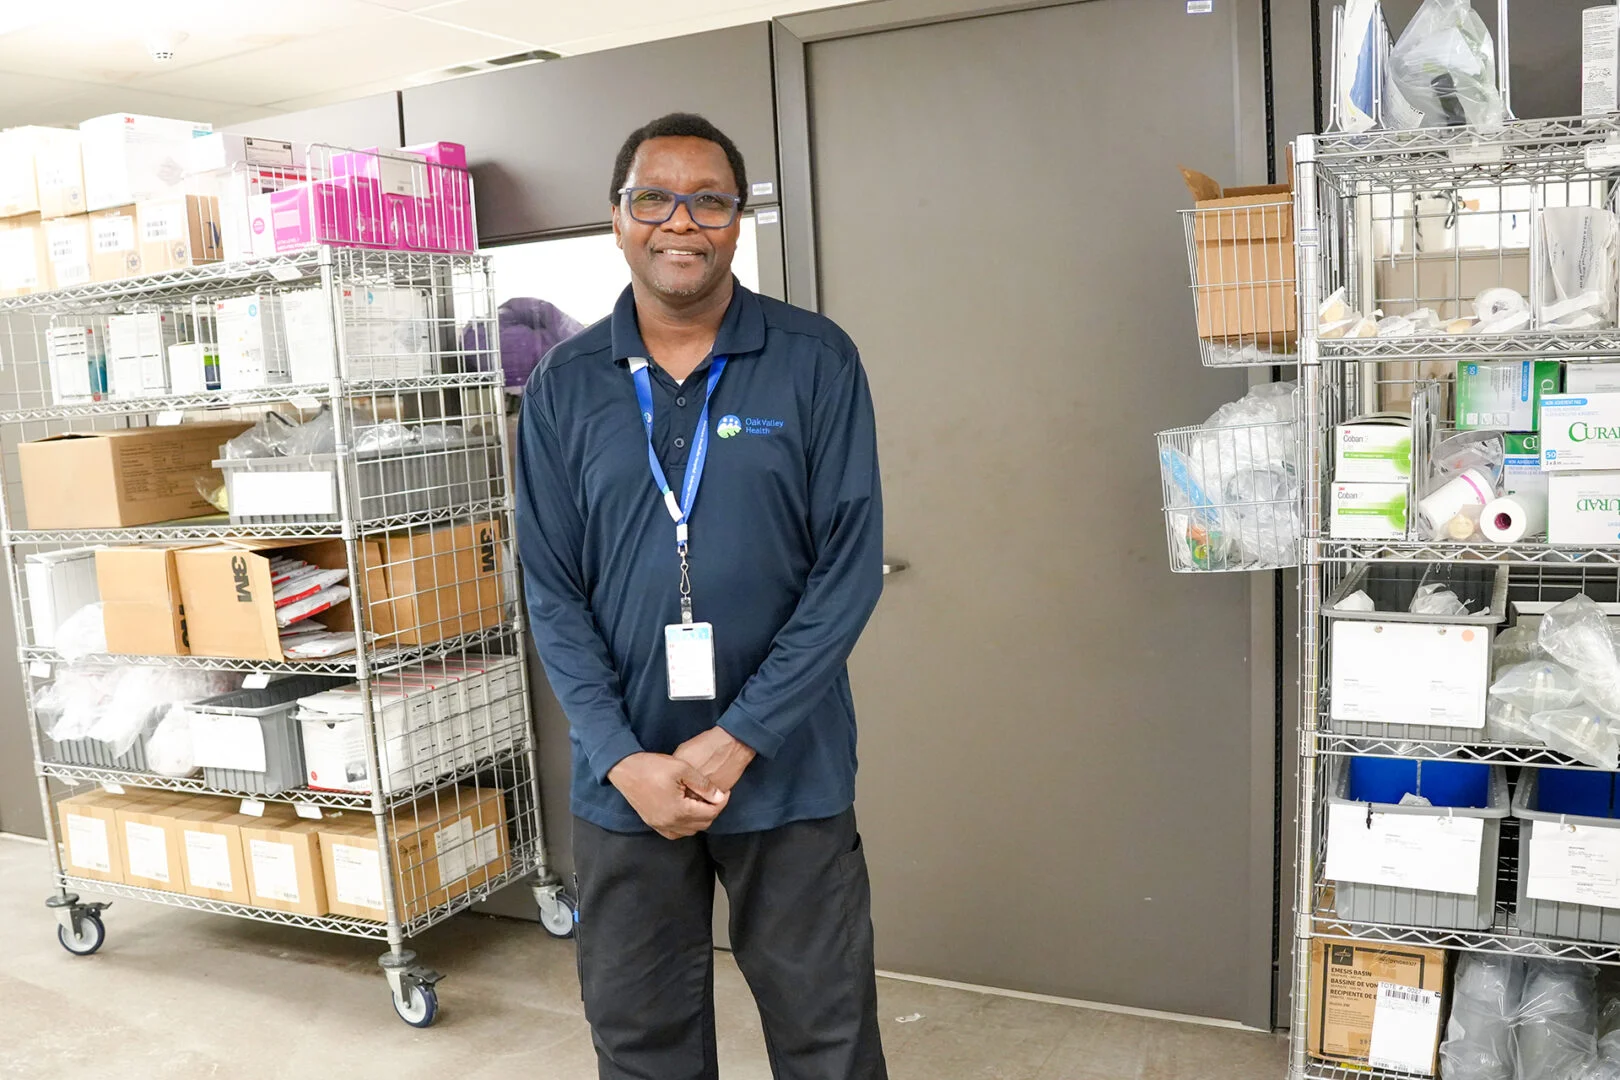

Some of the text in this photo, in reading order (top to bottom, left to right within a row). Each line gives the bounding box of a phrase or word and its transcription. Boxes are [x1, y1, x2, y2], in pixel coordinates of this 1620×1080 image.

[745, 418, 784, 428] Oak Valley
[1343, 435, 1364, 443] Coban
[1576, 498, 1620, 516] URAD
[480, 528, 498, 573] 3M
[231, 555, 252, 602] 3M
[1331, 967, 1353, 975] EMESIS
[1331, 978, 1356, 986] BASSINE
[1381, 982, 1396, 990] TOTE
[1330, 989, 1363, 998] RECIPIENTE
